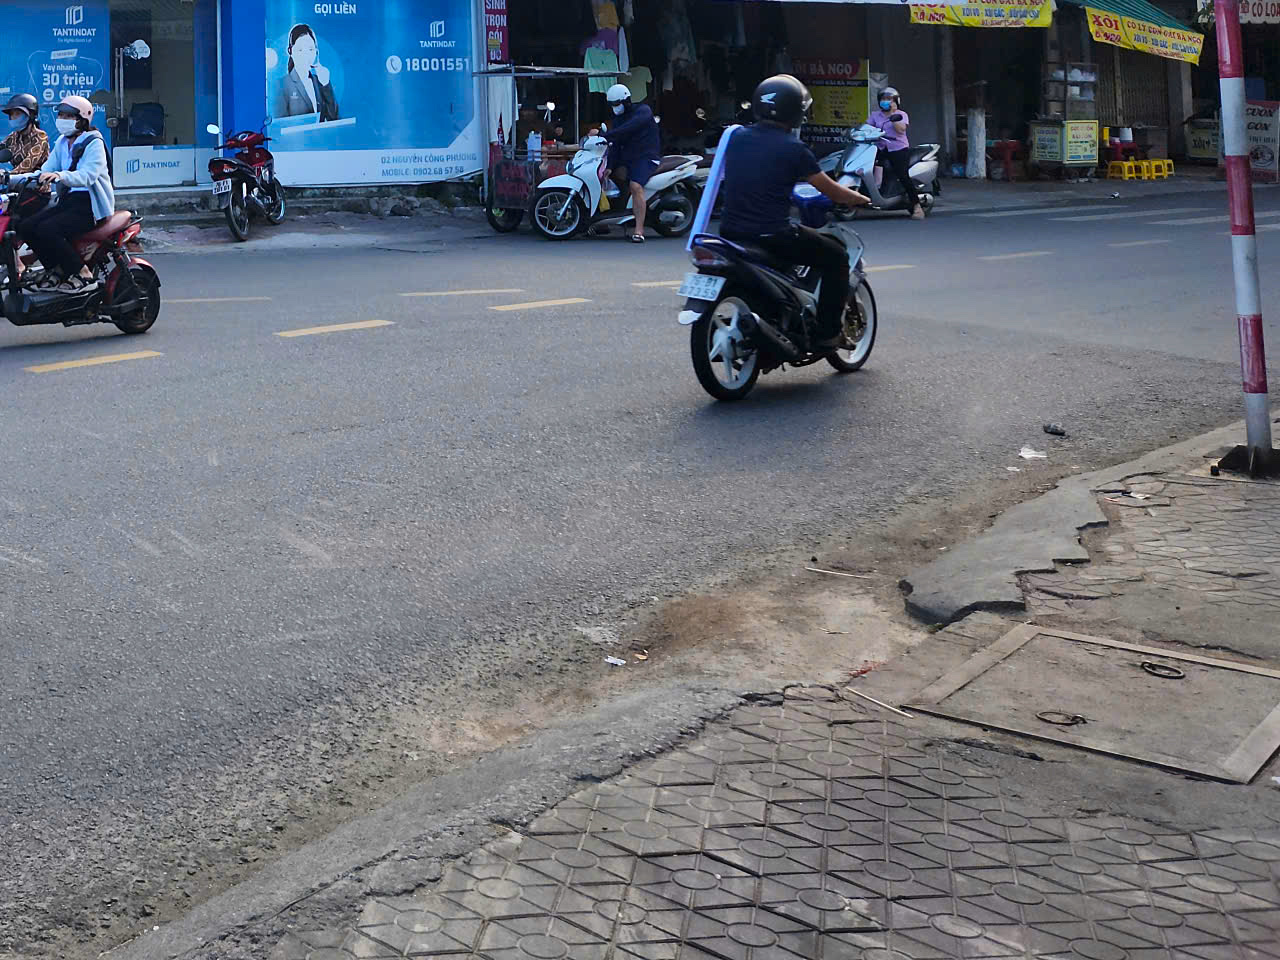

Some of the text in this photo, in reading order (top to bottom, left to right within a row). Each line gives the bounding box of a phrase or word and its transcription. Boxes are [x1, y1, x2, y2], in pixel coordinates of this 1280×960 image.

[314, 1, 357, 17] GỌI LIỀN
[52, 27, 97, 37] TANTINDAT
[419, 40, 456, 48] TANTINDAT
[42, 63, 77, 72] Vay nhanh
[405, 58, 469, 71] 18001551
[42, 73, 94, 89] 30 triệu
[142, 160, 182, 169] TANTINDAT
